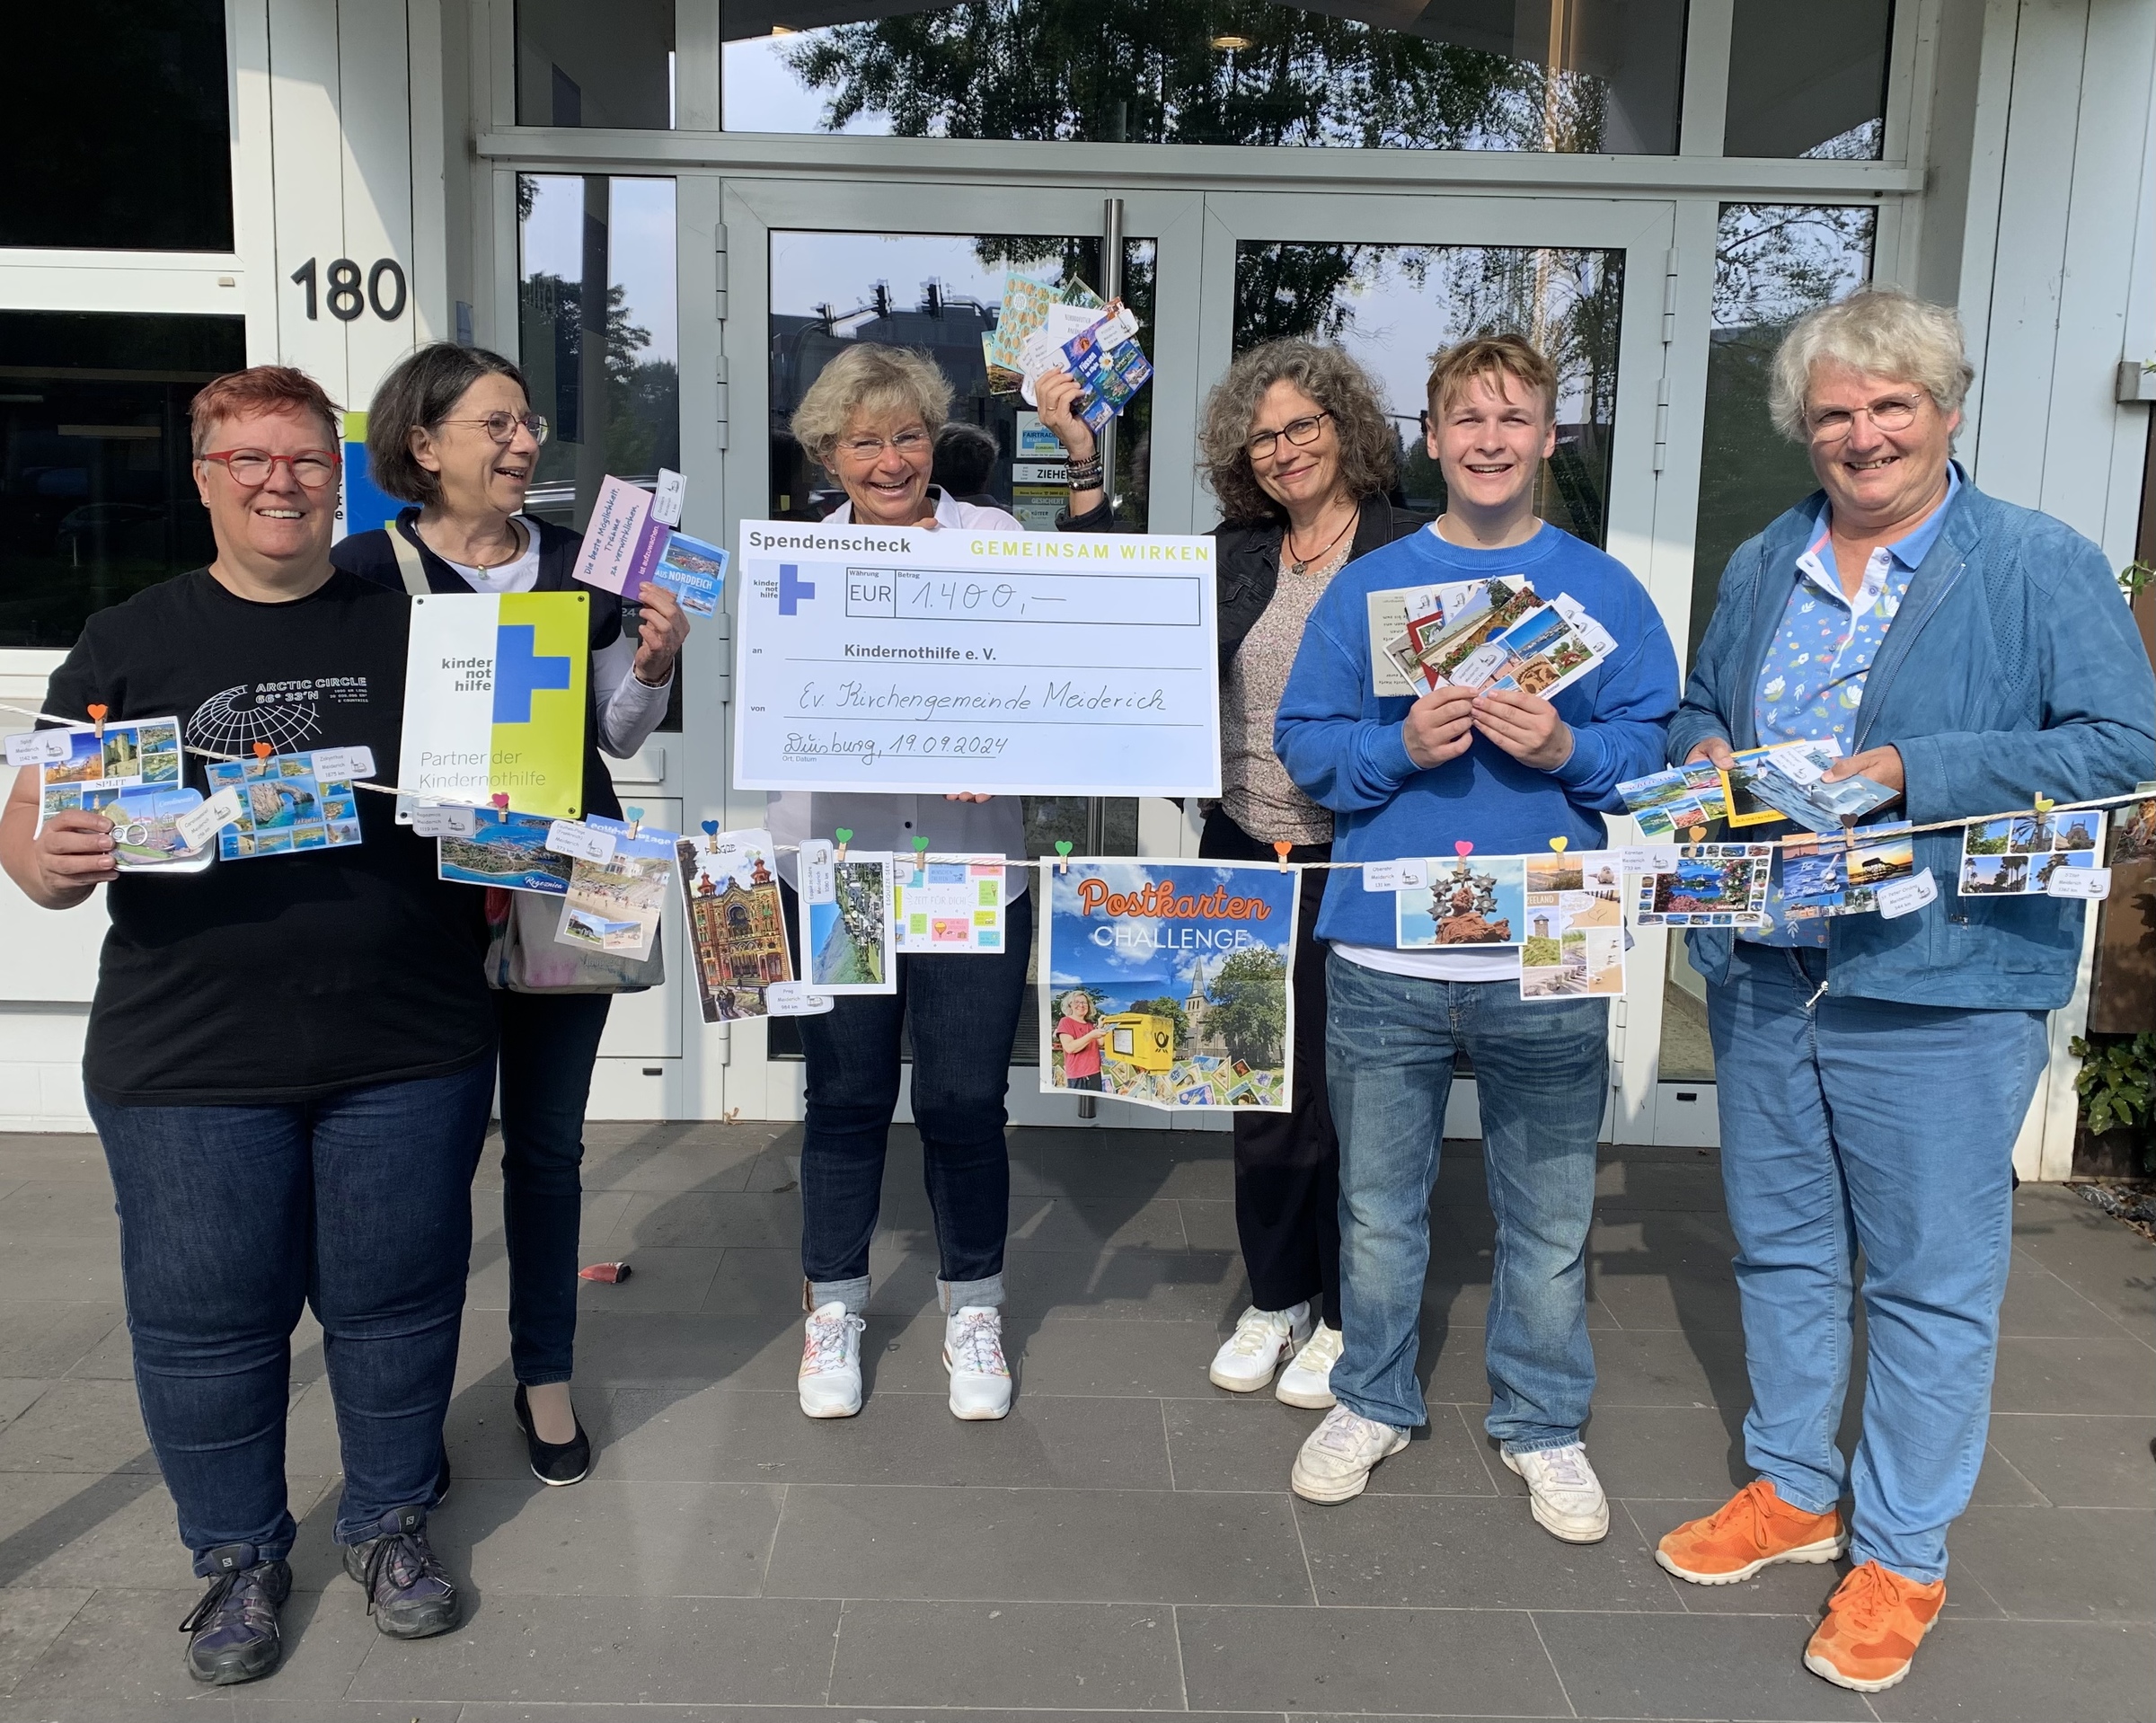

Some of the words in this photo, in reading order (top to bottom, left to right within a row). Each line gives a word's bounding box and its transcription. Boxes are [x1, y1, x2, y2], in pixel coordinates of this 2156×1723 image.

[290, 257, 407, 323] 180
[584, 561, 594, 576] Die
[591, 539, 602, 560] beste
[597, 489, 621, 537] Möglichkeit,
[604, 518, 621, 552] Träume
[610, 566, 617, 577] zu
[614, 505, 640, 562] verwirklichen,
[749, 532, 912, 553] Spendenscheck
[970, 540, 1110, 560] GEMEINSAM
[1119, 544, 1209, 561] WIRKEN
[638, 565, 646, 576] ist
[642, 525, 660, 567] aufzuwachen.
[655, 570, 667, 579] AUS
[668, 570, 713, 590] NORDDEICH
[849, 570, 879, 578] Währung
[753, 579, 779, 588] kinder
[760, 591, 779, 599] hilfe
[850, 584, 892, 603] EUR
[844, 644, 961, 660] Kindernothilfe
[965, 649, 978, 660] e.
[982, 648, 997, 660] V.
[441, 657, 493, 669] kinder
[465, 668, 492, 679] not
[255, 680, 312, 693] ARCTIC
[314, 677, 367, 688] CIRCLE
[454, 680, 492, 692] hilfe
[255, 694, 281, 704] 66°
[800, 681, 825, 710] Ev.
[836, 680, 1031, 721] Kirchengemeinde
[1042, 681, 1166, 711] Meiderich
[15, 746, 40, 754] Meiderich
[888, 734, 1009, 755] 19.09.2024
[420, 751, 488, 766] Partner
[491, 750, 523, 764] der
[95, 779, 127, 788] SPLIT
[419, 771, 546, 789] Kindernothilfe
[554, 836, 579, 848] Meiderich
[555, 844, 566, 853] 373
[525, 875, 564, 890] Rogoznica
[1888, 889, 1902, 898] Peter
[1902, 884, 1919, 895] Ording
[914, 897, 929, 906] ZEIT
[930, 895, 945, 906] FÜR
[1078, 878, 1272, 922] Postkarten
[1527, 895, 1554, 906] ZEELAND
[1889, 894, 1913, 905] Meiderich
[1094, 926, 1249, 950] CHALLENGE
[777, 995, 801, 1003] Meiderich
